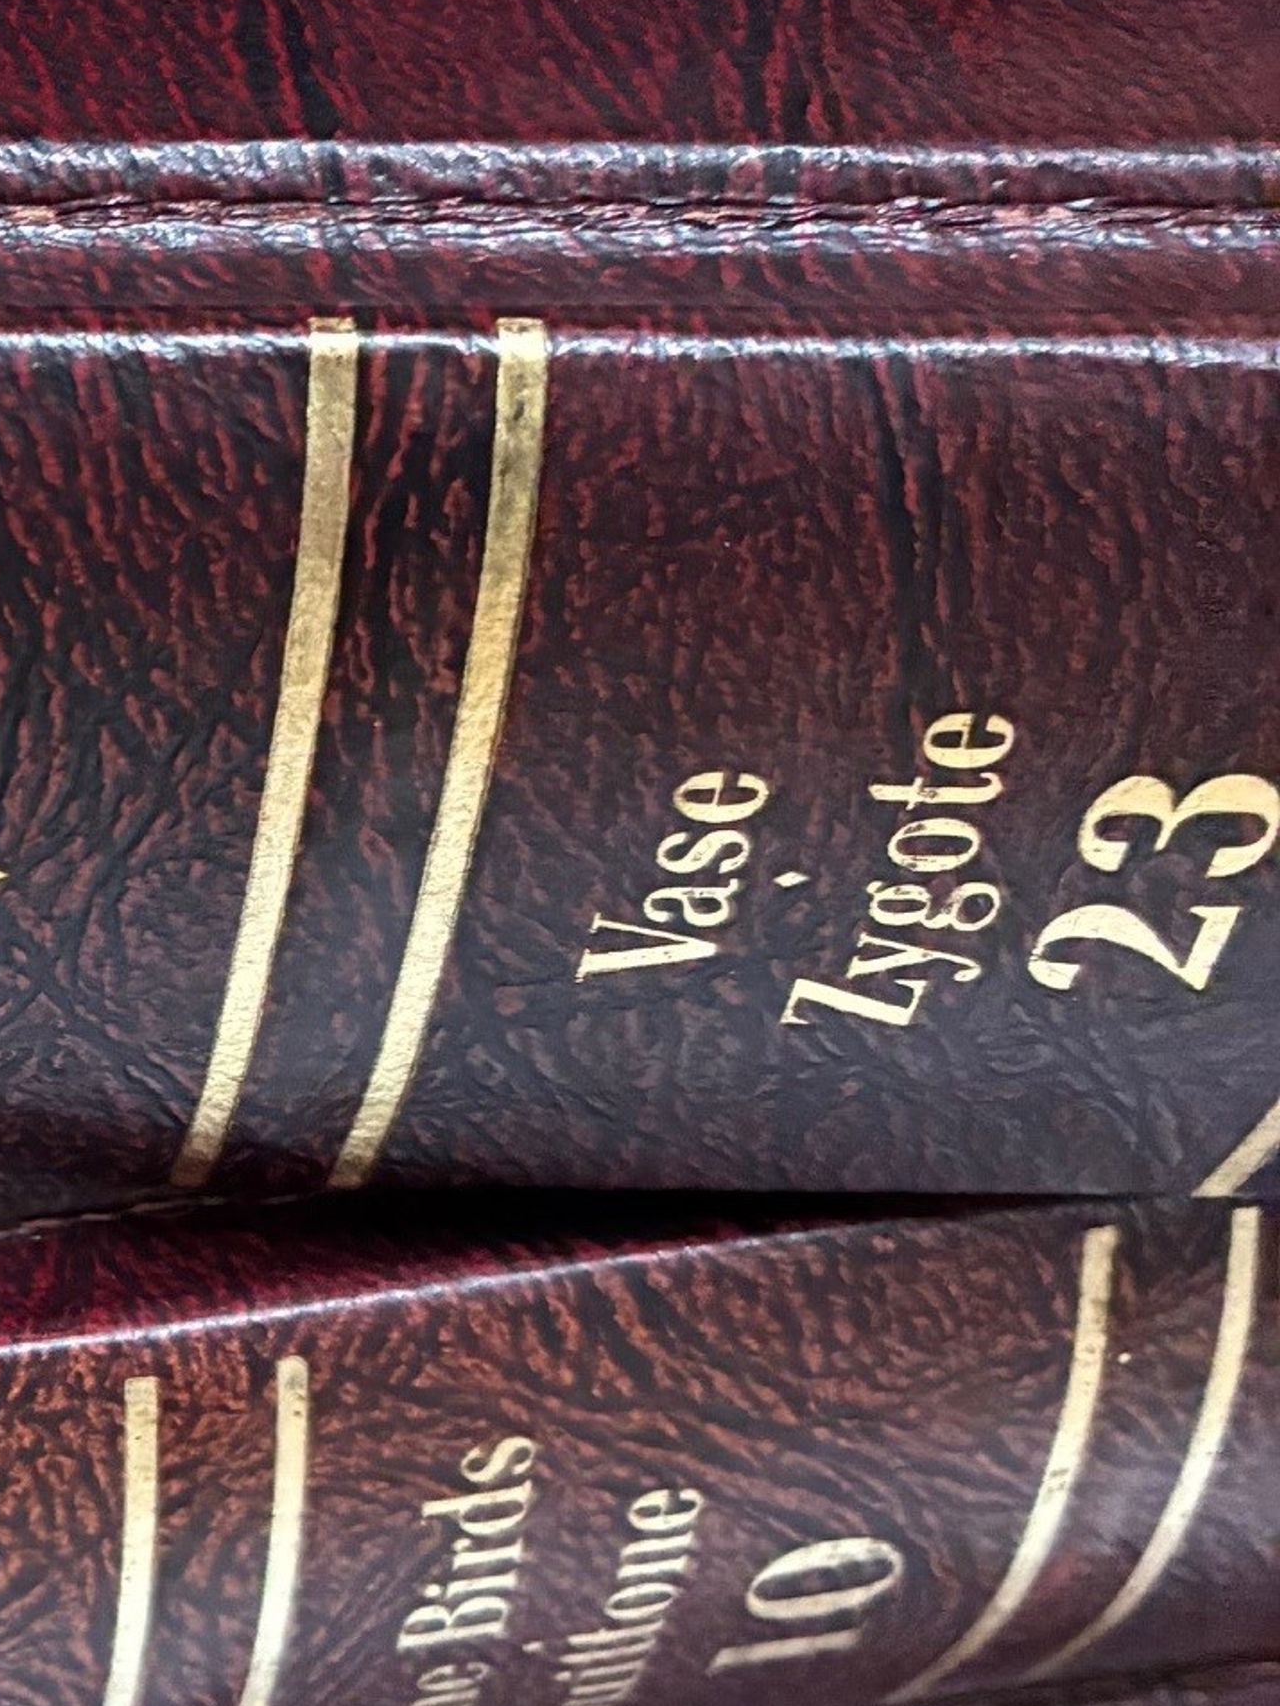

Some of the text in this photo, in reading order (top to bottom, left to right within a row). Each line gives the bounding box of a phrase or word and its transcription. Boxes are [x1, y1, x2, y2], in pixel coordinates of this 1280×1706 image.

[574, 770, 771, 985] Vase
[779, 712, 1017, 1028] Zygote
[1027, 773, 1280, 990] 23
[395, 1435, 540, 1652] Birds
[707, 1537, 904, 1676] 10
